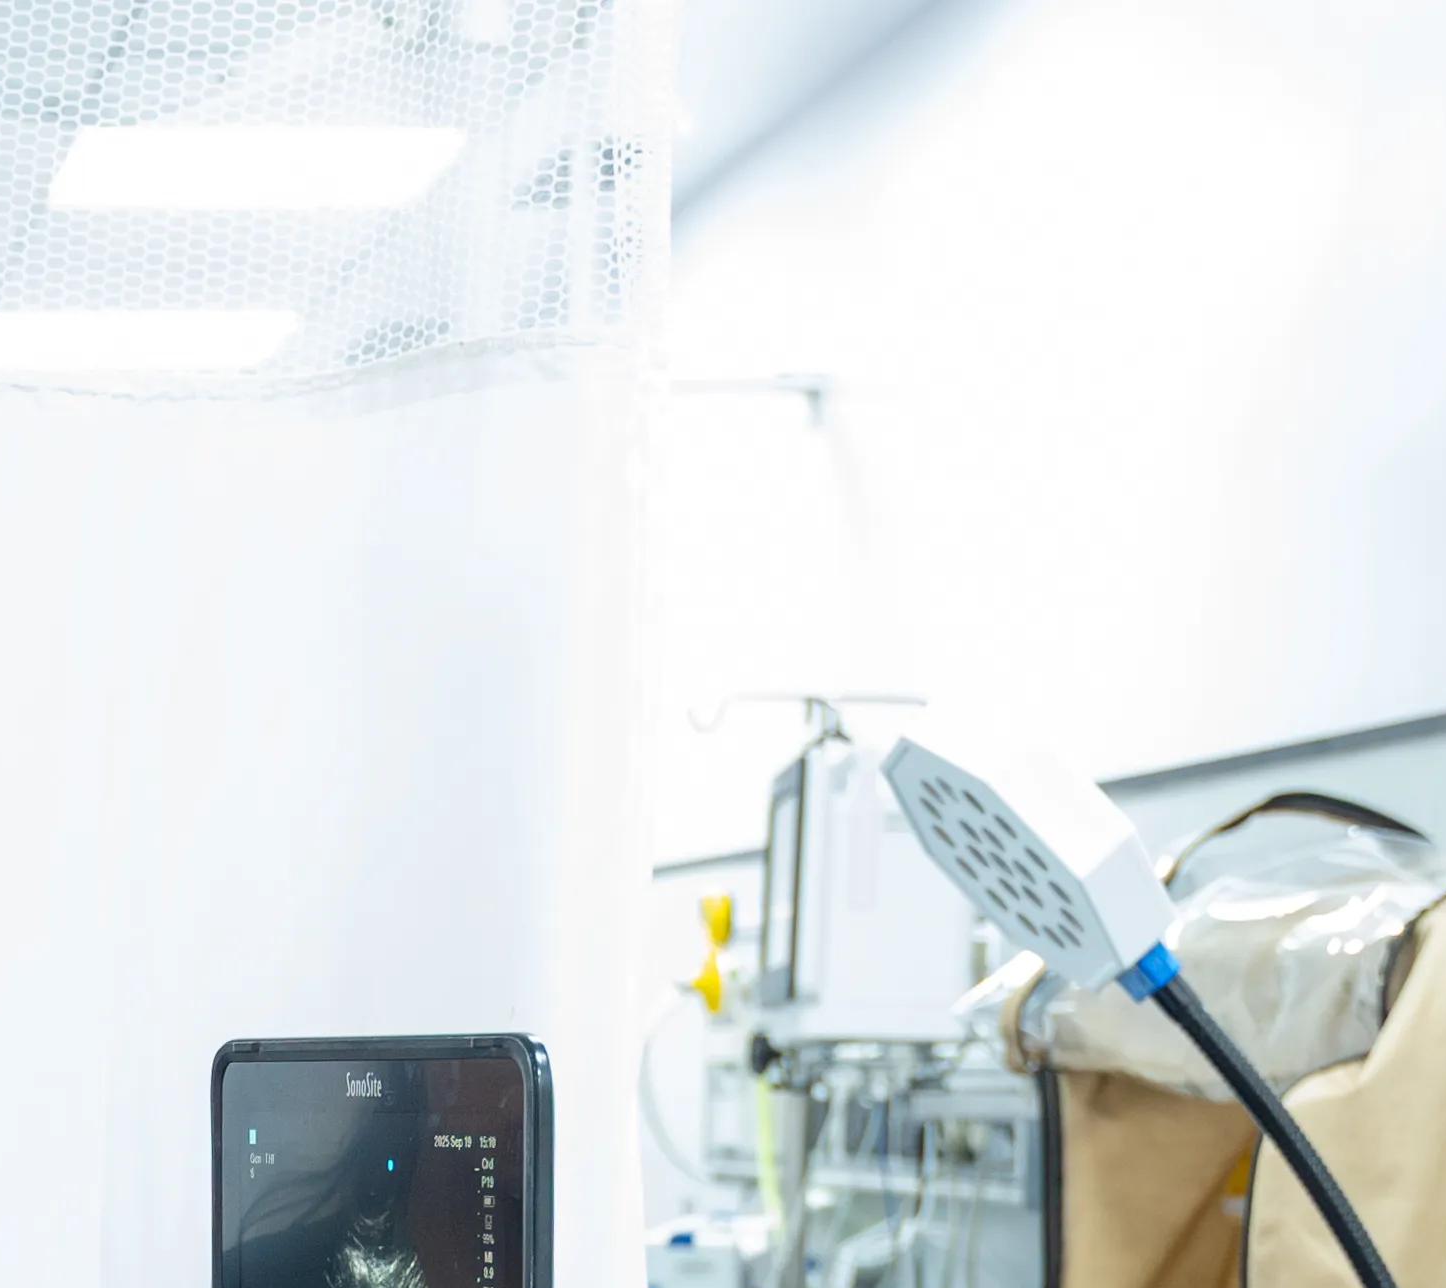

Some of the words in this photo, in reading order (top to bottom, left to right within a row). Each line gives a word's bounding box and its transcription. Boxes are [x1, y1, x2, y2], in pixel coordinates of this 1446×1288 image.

[346, 1072, 382, 1098] SonoSite
[433, 1135, 450, 1148] 2025
[450, 1135, 463, 1151] Sep
